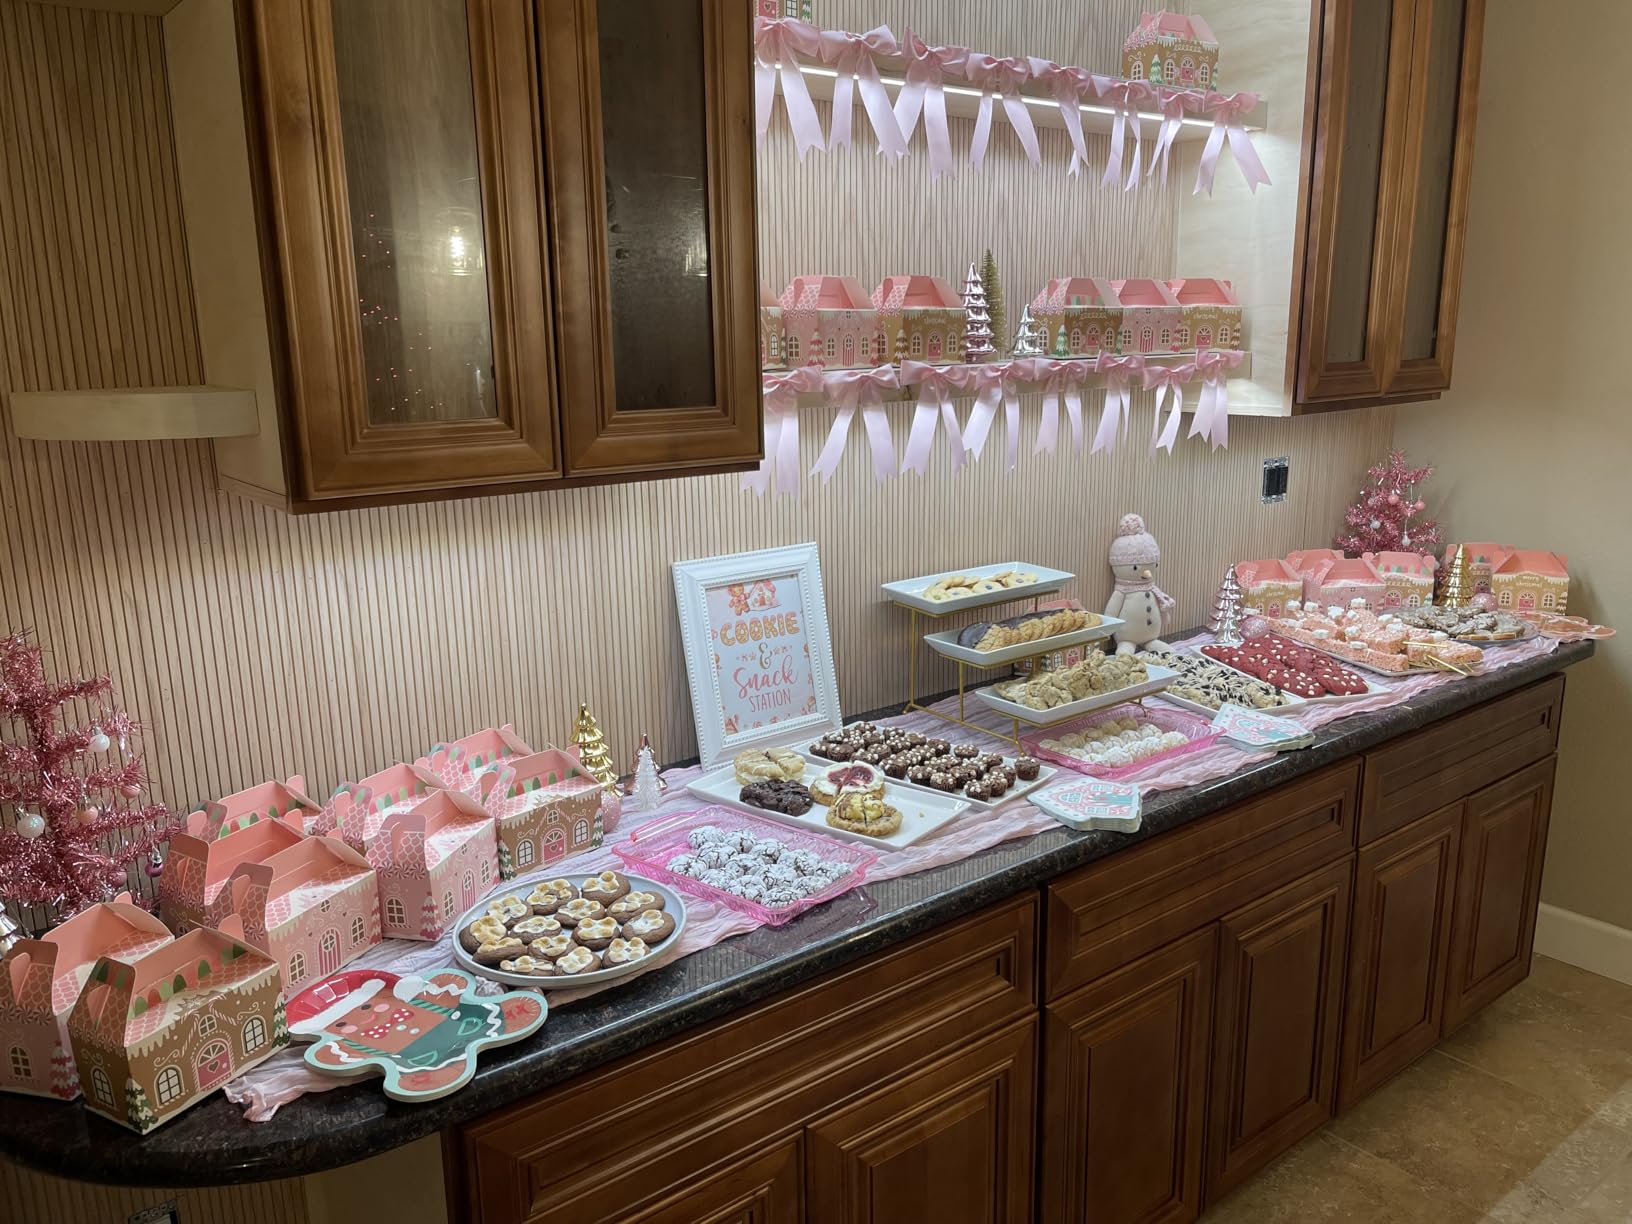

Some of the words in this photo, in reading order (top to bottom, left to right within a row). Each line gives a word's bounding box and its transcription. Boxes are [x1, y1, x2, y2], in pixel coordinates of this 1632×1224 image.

[721, 612, 800, 646] COOKIE
[758, 643, 772, 669] &
[734, 656, 797, 698] Snack
[750, 689, 792, 713] STATION
